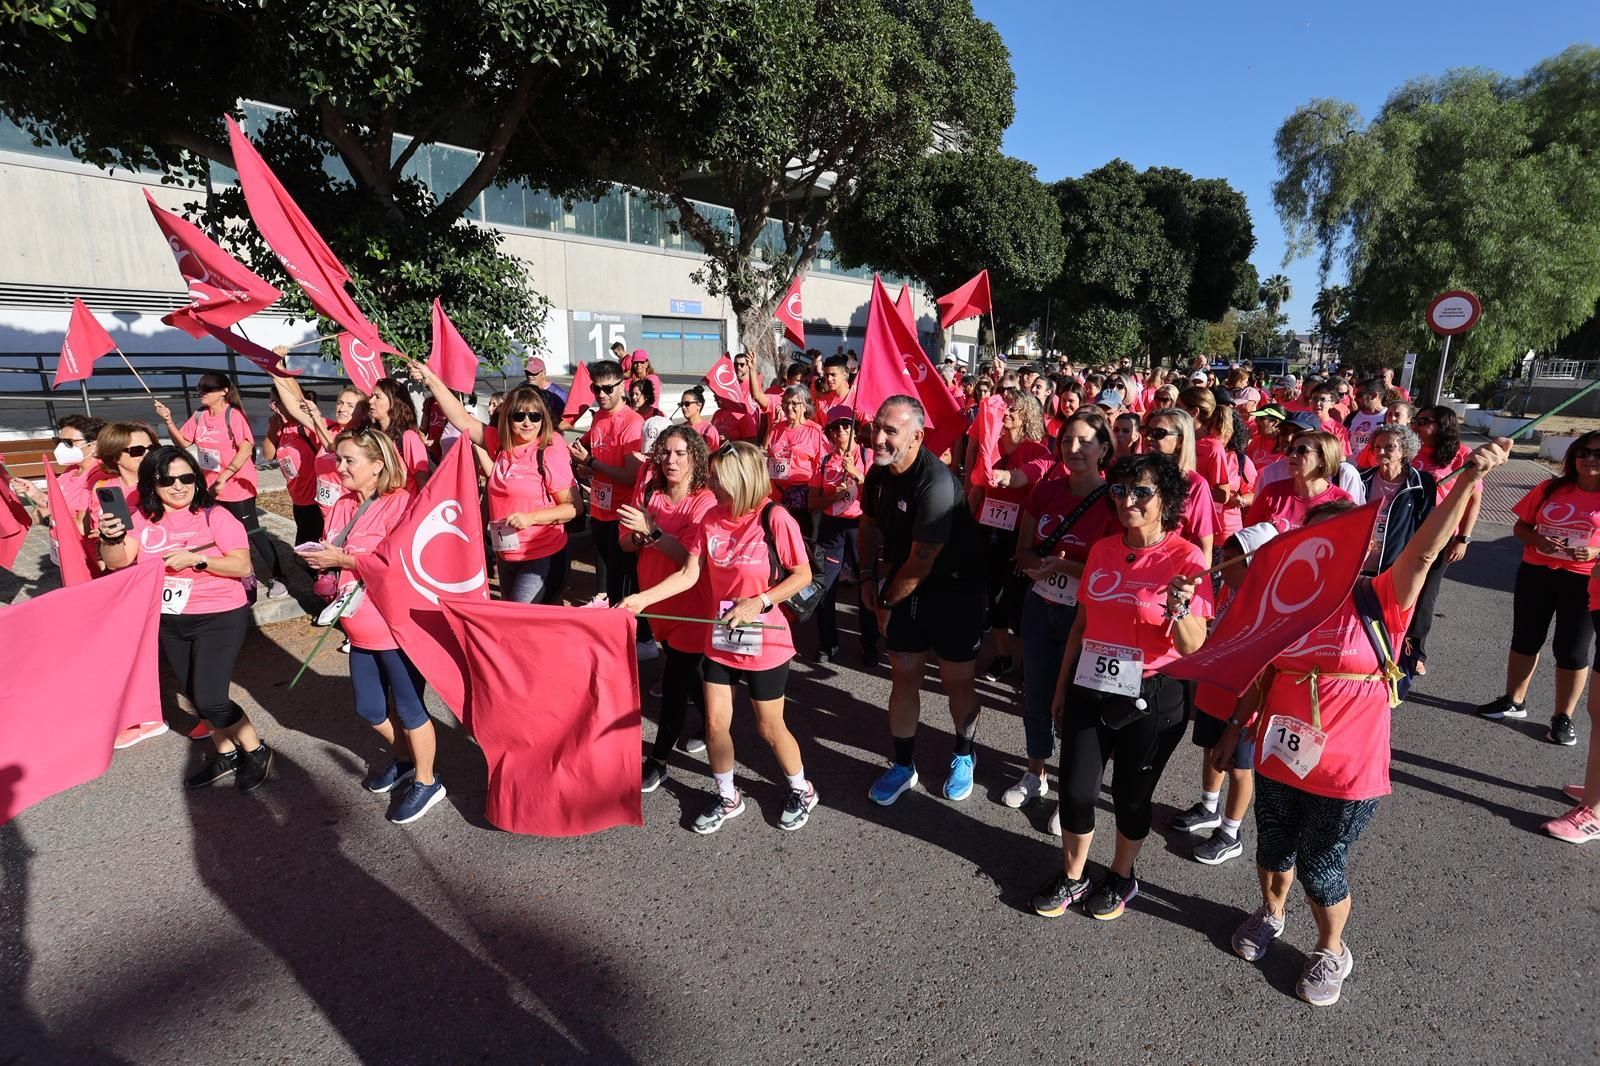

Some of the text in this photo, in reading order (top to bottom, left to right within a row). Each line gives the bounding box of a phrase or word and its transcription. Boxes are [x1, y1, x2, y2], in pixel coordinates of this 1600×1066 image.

[675, 301, 685, 313] 15
[588, 322, 627, 361] 15
[320, 487, 330, 499] 85
[989, 507, 1008, 521] 171
[1337, 648, 1358, 657] JEREZ
[1095, 655, 1120, 676] 56
[1277, 727, 1300, 752] 18
